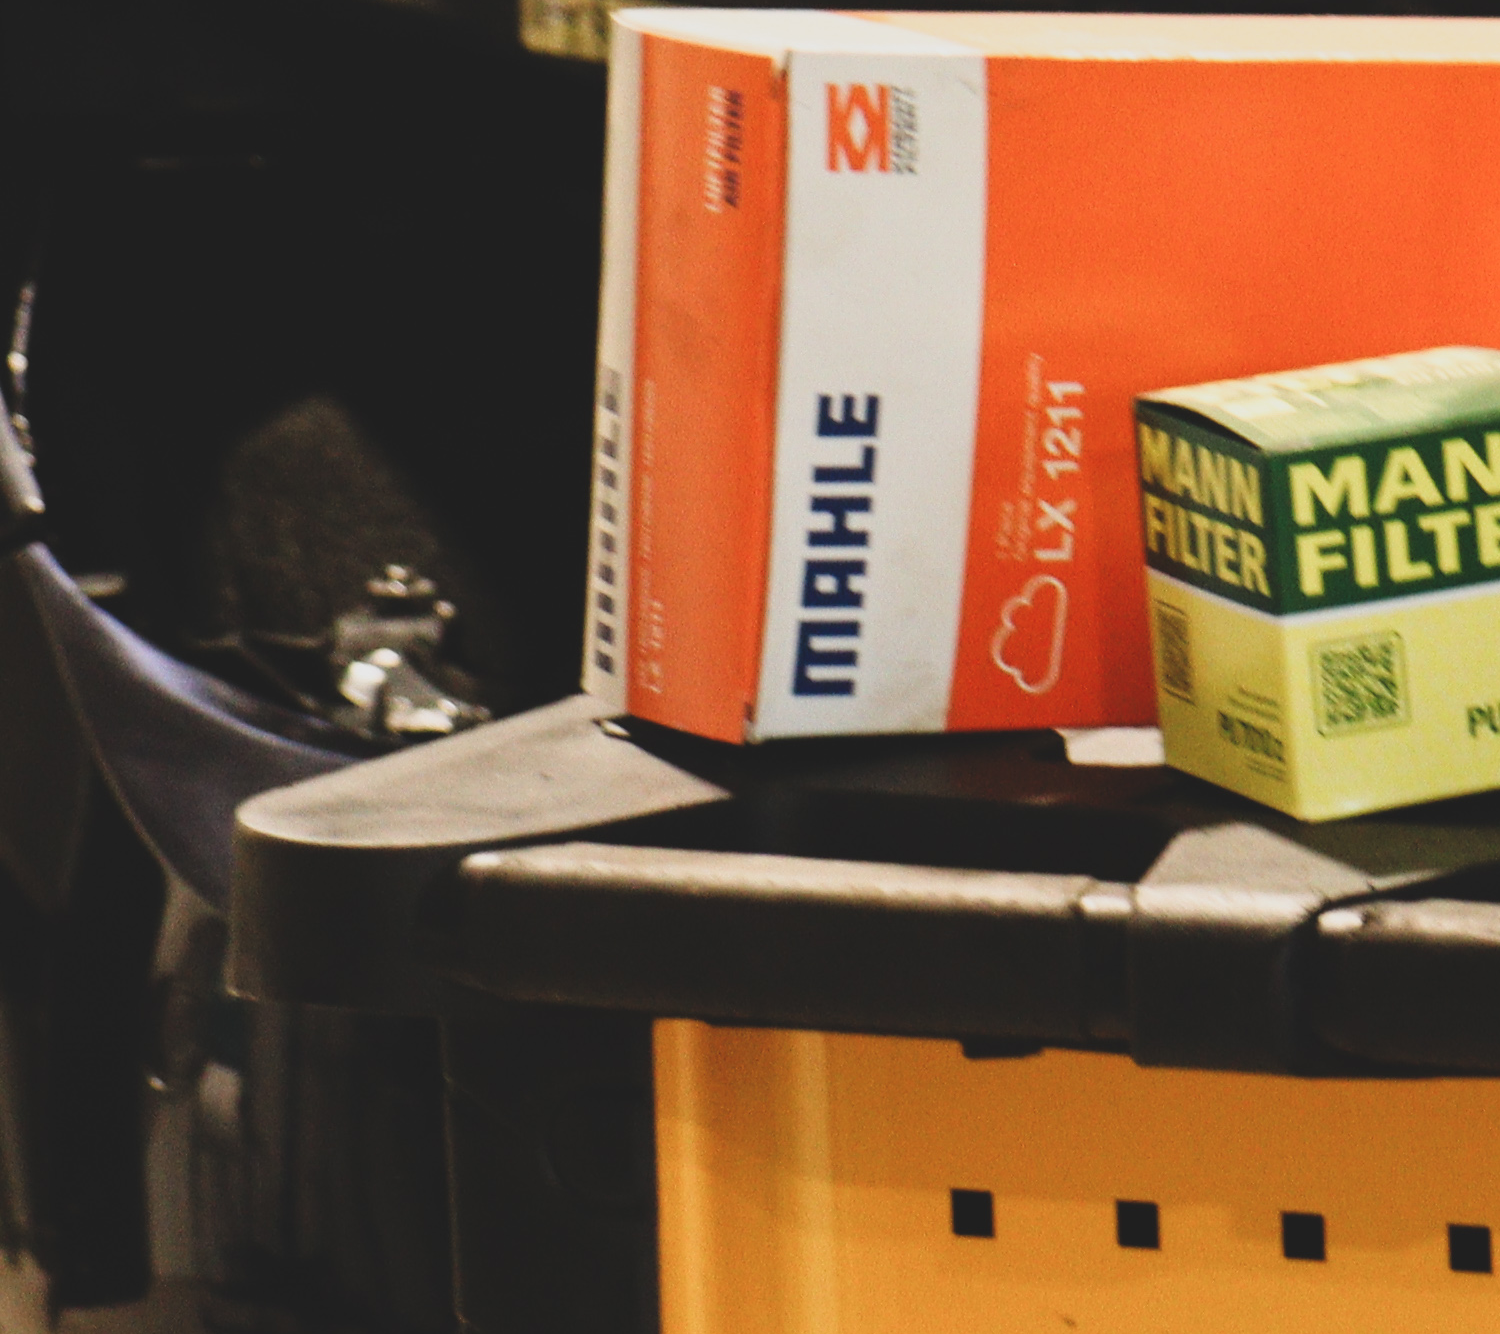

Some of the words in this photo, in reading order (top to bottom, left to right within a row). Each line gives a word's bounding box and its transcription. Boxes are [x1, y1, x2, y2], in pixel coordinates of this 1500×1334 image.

[1042, 381, 1085, 480] 1211
[1139, 421, 1264, 528] MANN
[794, 393, 879, 697] MAHLE
[1033, 498, 1076, 562] LX
[1146, 490, 1272, 599] FILTER
